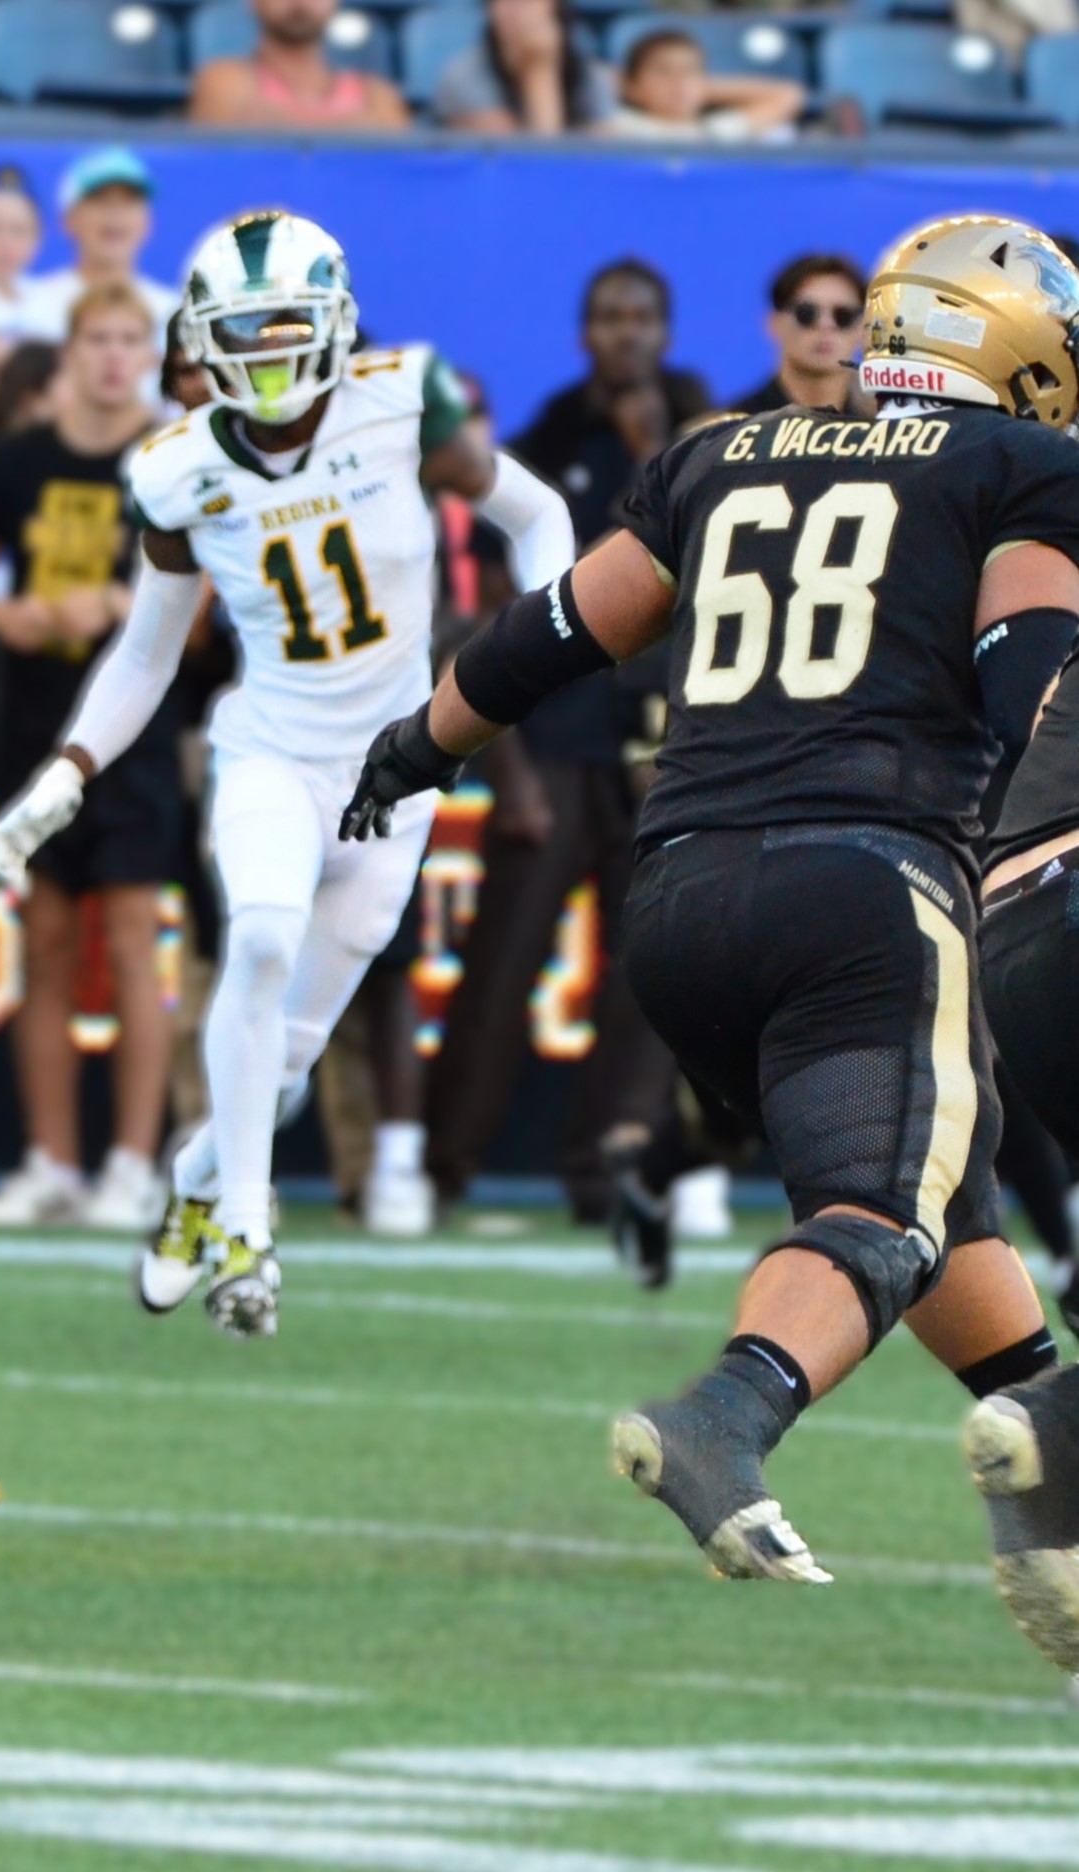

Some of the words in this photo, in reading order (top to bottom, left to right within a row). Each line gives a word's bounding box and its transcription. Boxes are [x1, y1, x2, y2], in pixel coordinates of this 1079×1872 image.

[889, 335, 906, 355] 68
[864, 366, 945, 393] Riddell
[724, 424, 756, 461] G.
[771, 417, 951, 459] VACCARO
[259, 493, 342, 532] REGINA
[260, 518, 389, 664] 11
[683, 482, 900, 706] 68
[898, 859, 954, 914] MANITOBA
